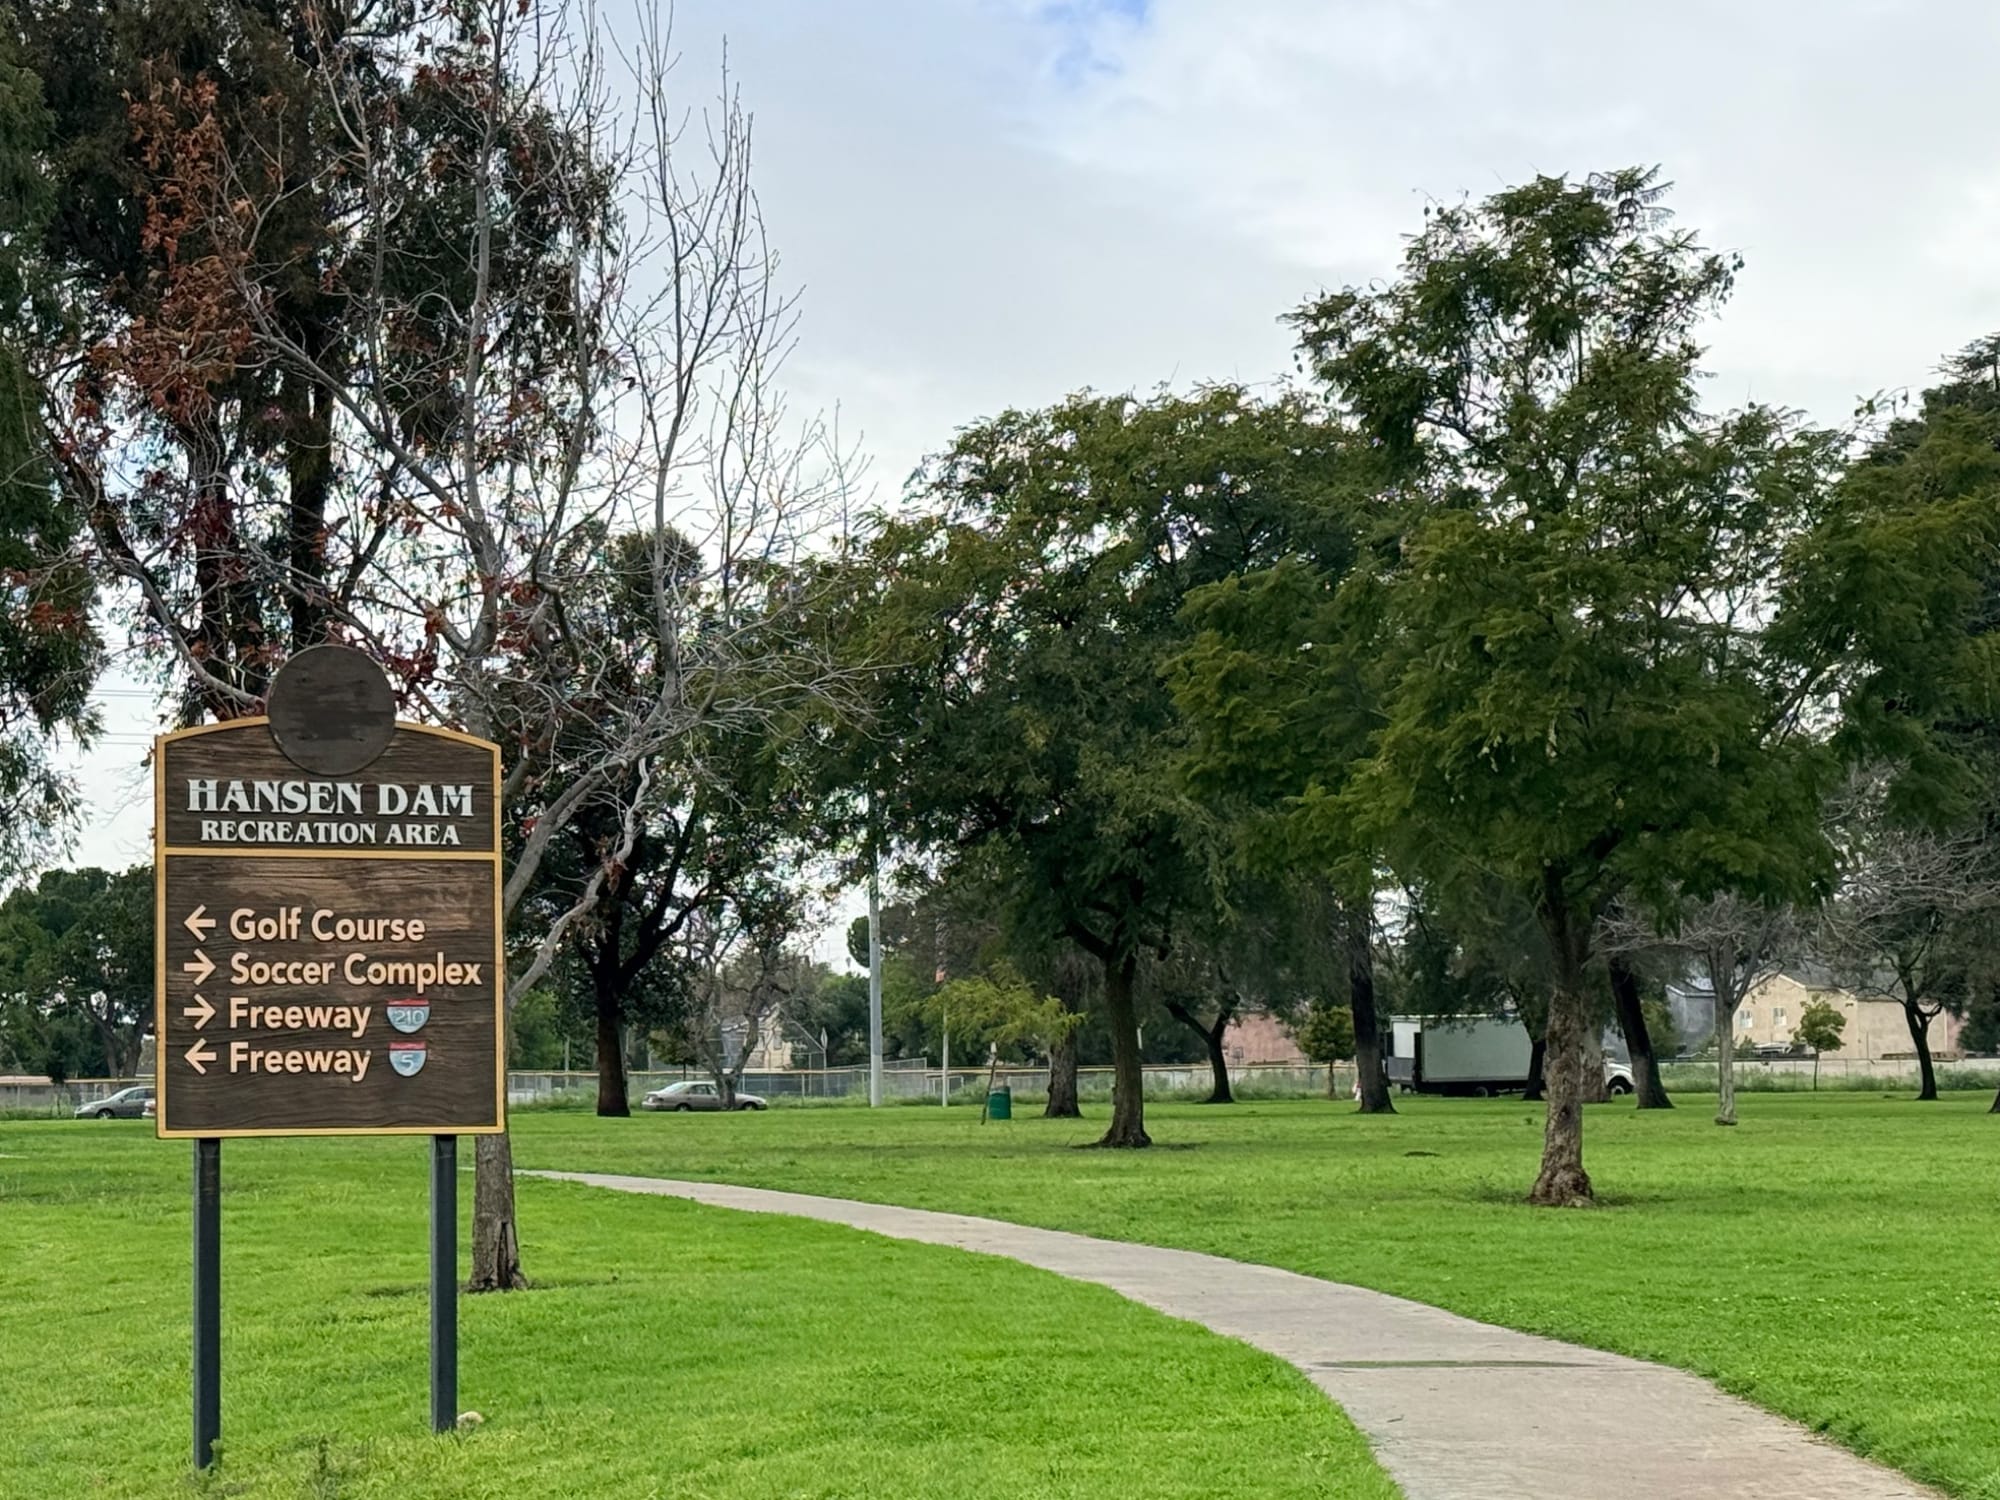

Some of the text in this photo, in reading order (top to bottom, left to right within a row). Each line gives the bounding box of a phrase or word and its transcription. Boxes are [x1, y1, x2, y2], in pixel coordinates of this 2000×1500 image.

[186, 779, 475, 817] HANSEN DAM
[200, 820, 461, 846] RECREATION AREA
[229, 907, 426, 942] Golf Course
[230, 952, 483, 994] Soccer Complex
[229, 997, 425, 1037] Freeway 210
[229, 1042, 414, 1082] Freeway 5
